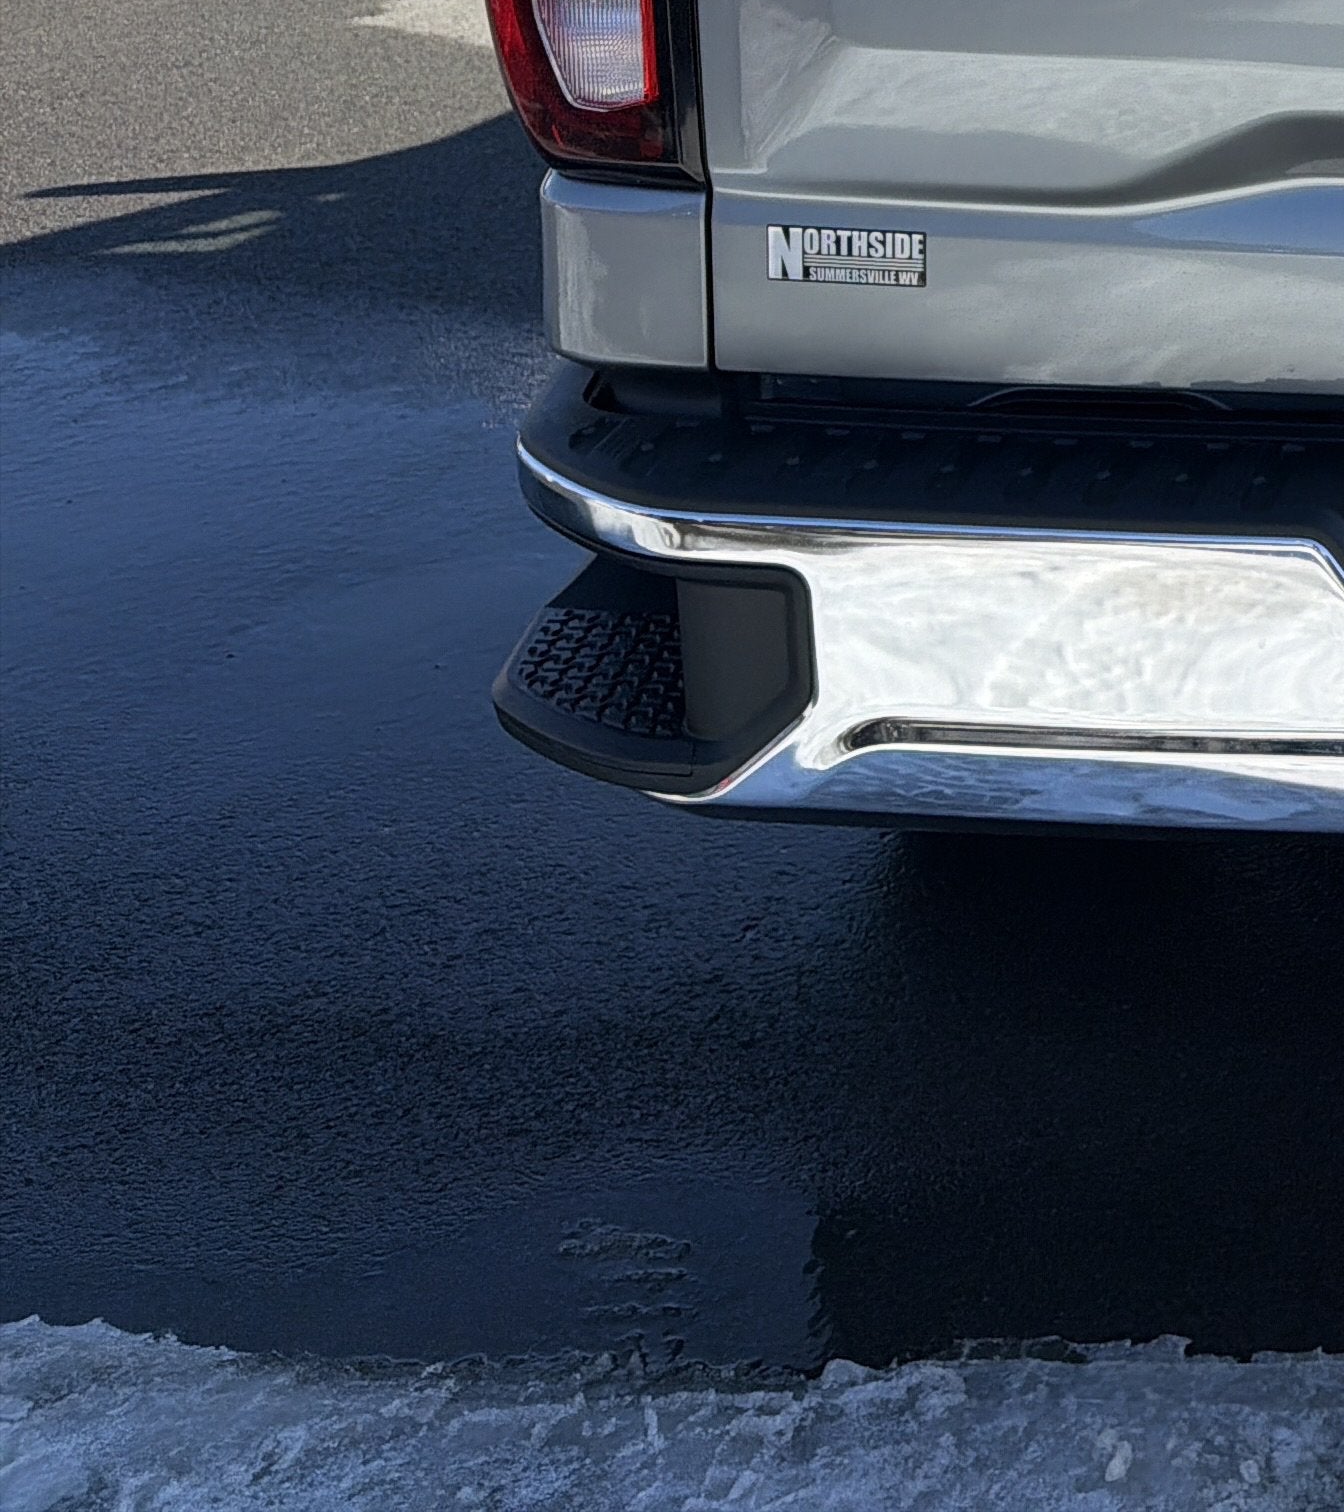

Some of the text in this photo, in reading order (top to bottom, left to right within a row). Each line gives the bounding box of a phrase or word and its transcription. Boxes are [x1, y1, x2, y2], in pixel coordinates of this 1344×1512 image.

[767, 226, 925, 281] NORTHSIDE
[809, 267, 920, 286] SUMMERSVILLE WV
